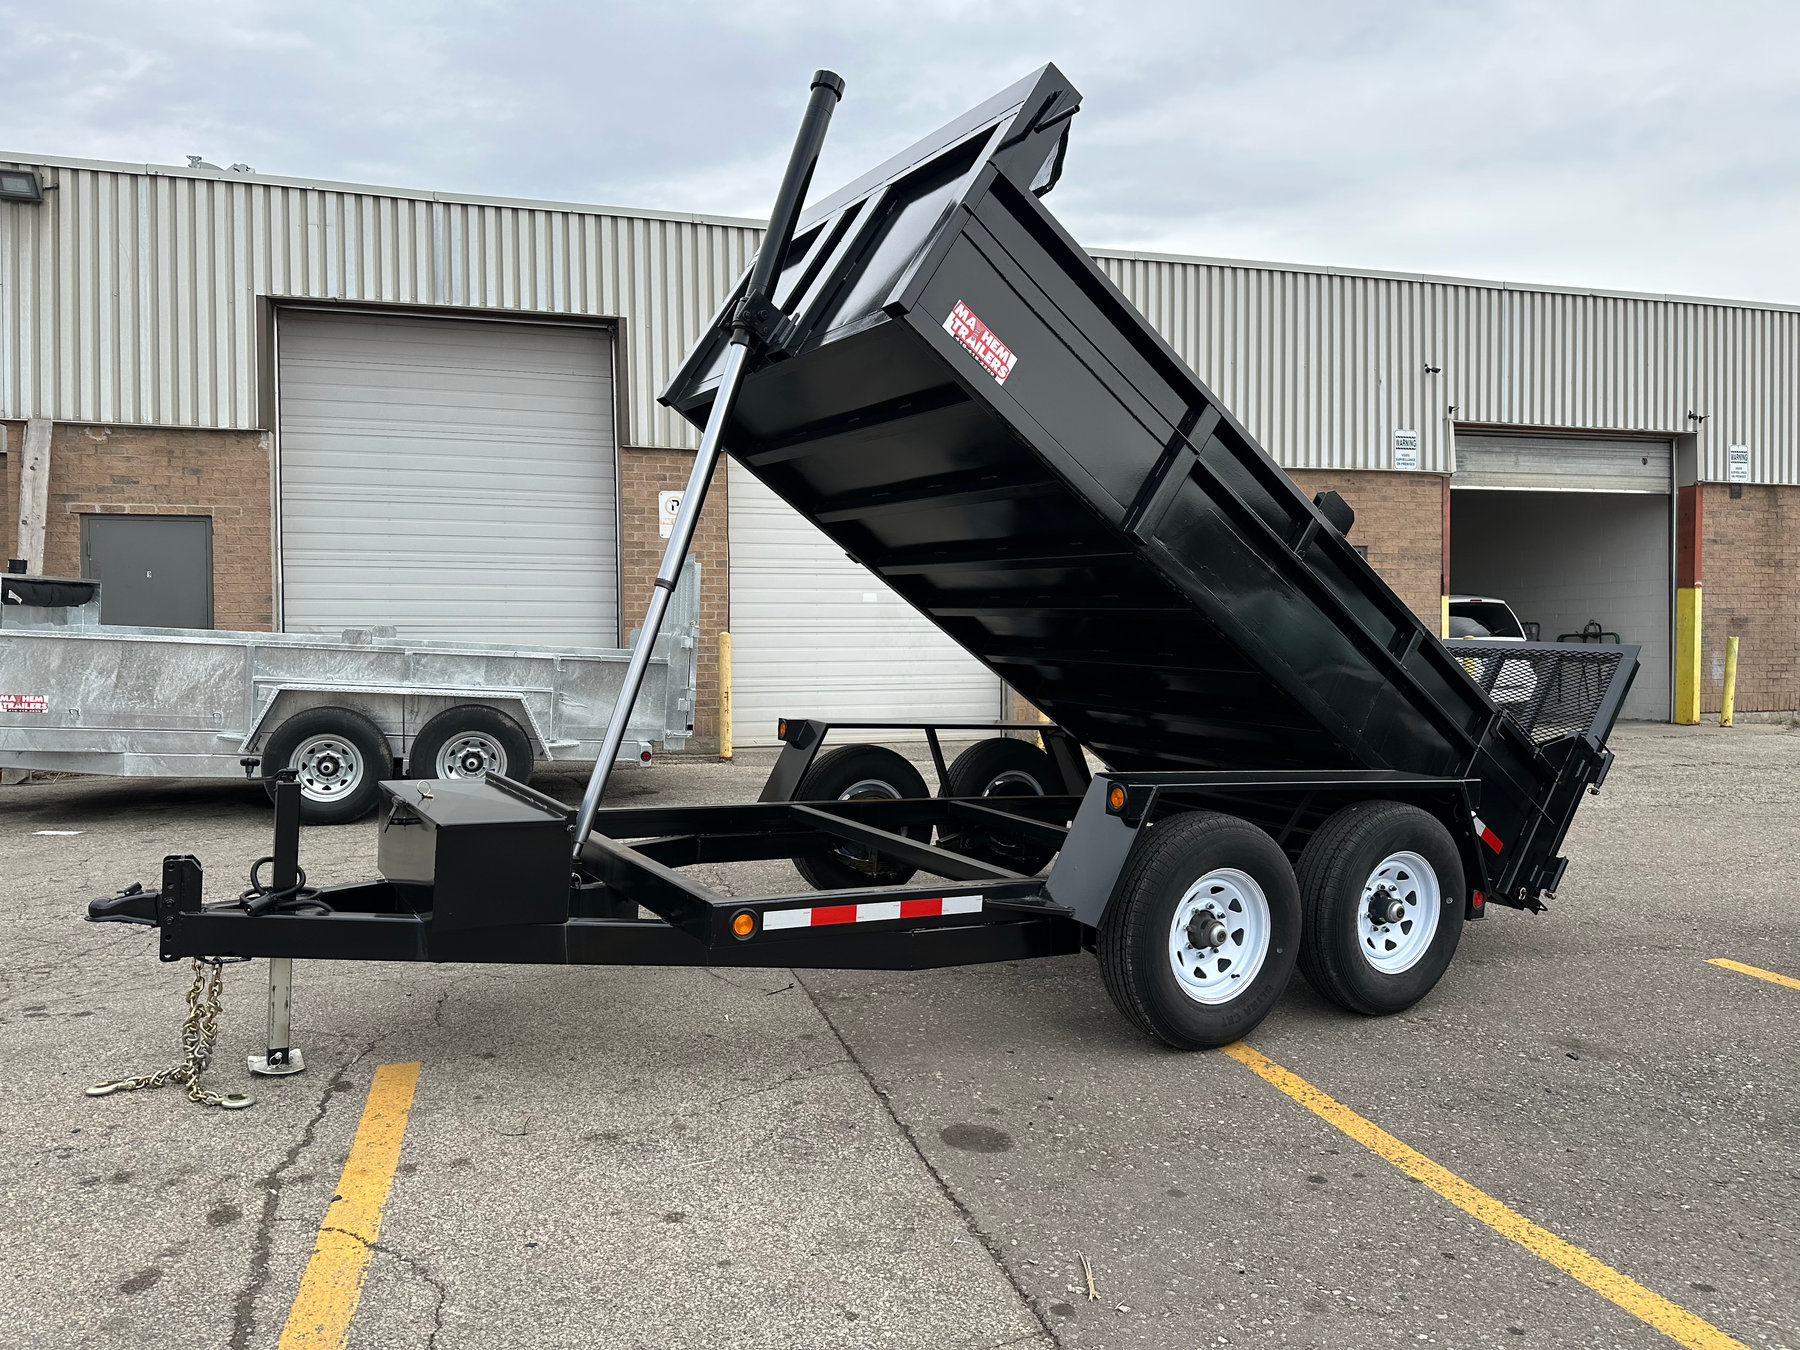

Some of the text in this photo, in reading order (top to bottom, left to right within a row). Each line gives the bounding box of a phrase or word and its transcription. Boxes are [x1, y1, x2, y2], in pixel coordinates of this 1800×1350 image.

[951, 317, 1009, 378] TRAILERS
[1396, 439, 1416, 447] WARNING
[3, 702, 47, 710] TRAILERS
